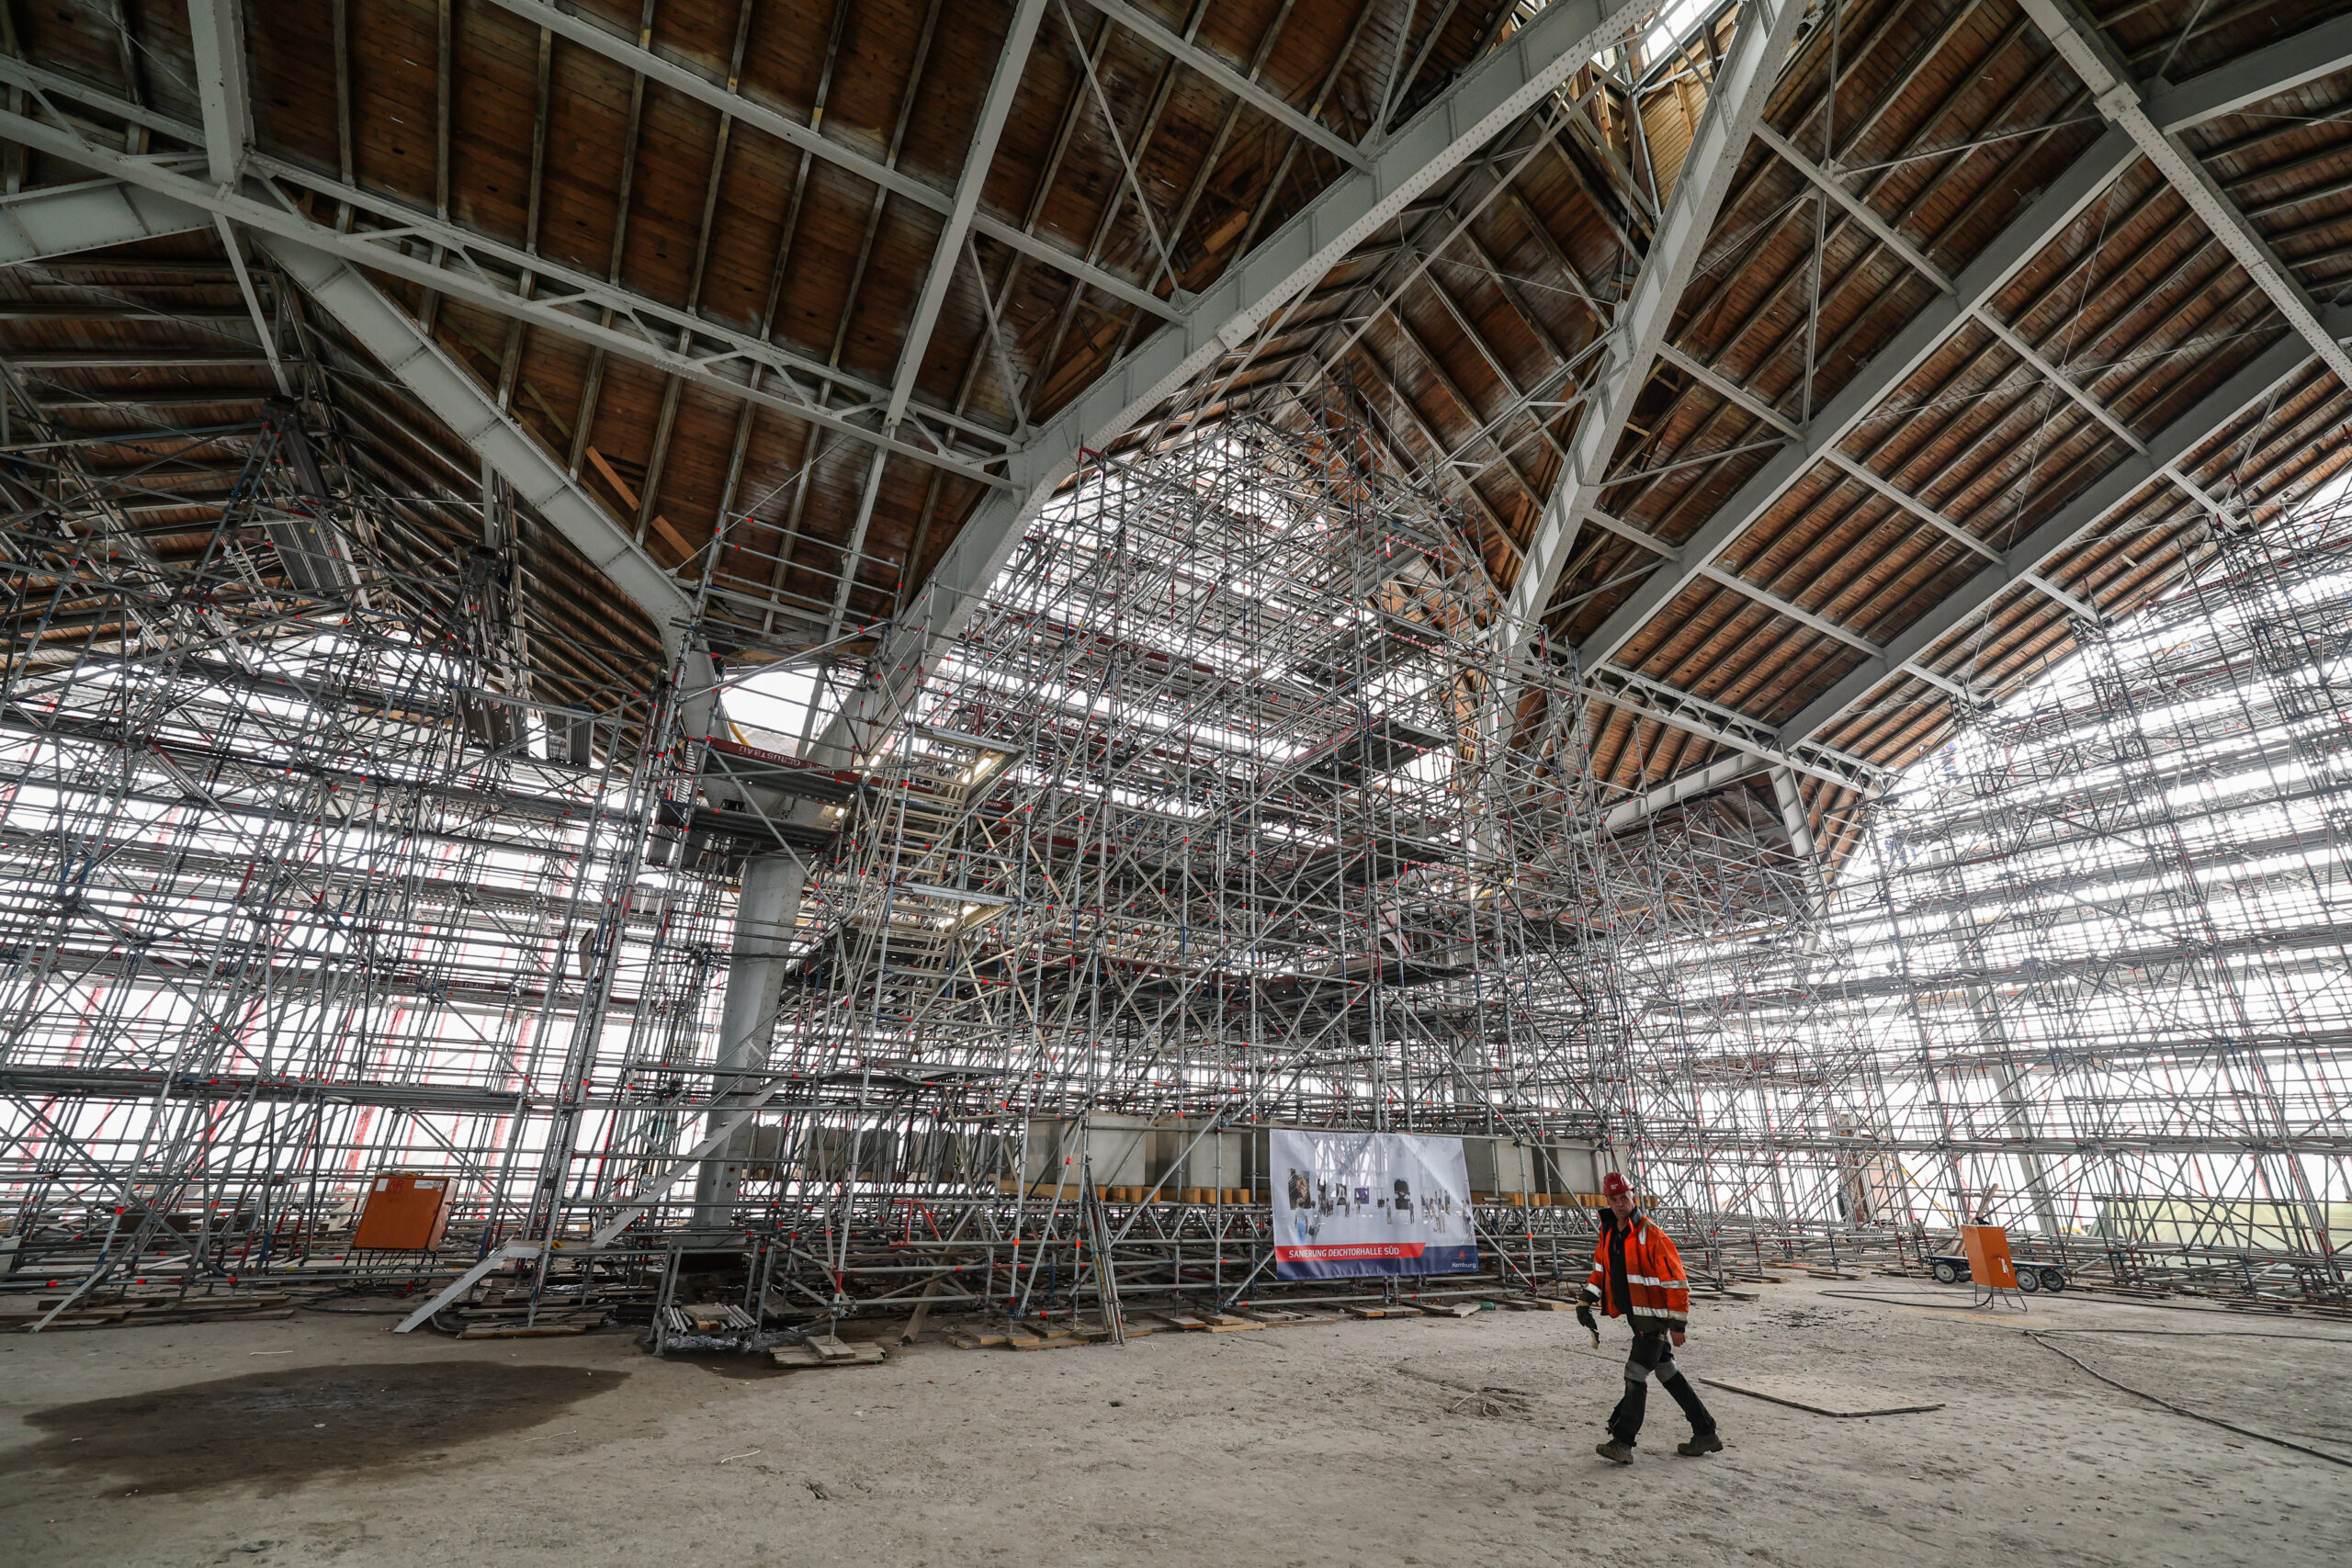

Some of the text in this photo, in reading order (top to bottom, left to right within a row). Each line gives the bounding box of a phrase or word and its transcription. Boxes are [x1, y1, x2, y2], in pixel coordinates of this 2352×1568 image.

[1288, 1246, 1400, 1258] SANIERUNG DEICHTORHALLE SÜD
[1452, 1261, 1476, 1269] Hamburg
